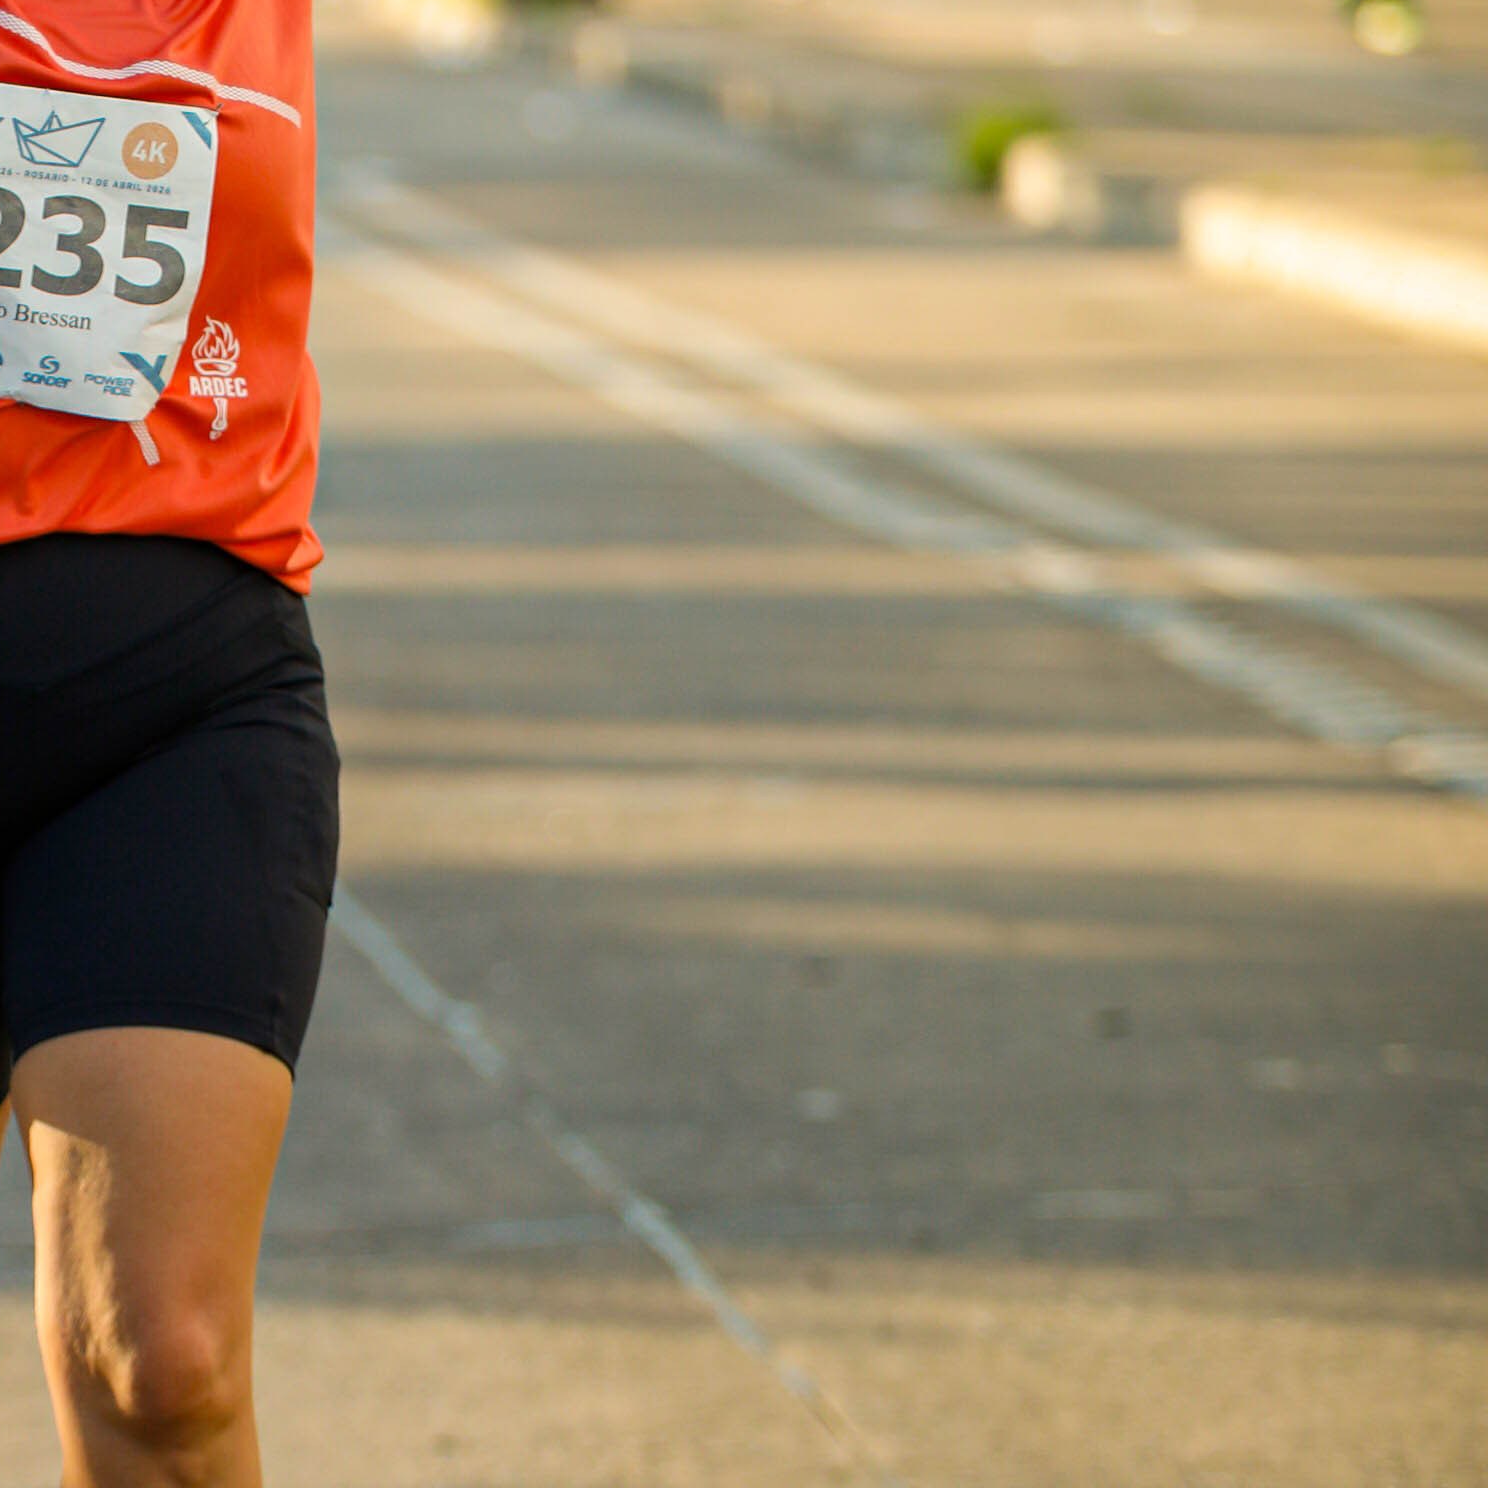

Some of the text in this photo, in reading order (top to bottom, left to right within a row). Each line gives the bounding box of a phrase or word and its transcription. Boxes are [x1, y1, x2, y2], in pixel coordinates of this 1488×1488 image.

[131, 137, 169, 164] 4K
[23, 169, 69, 183] ROSARIO
[81, 177, 94, 186] 12
[95, 178, 109, 188] DE
[112, 180, 142, 192] ABRIL
[146, 184, 172, 195] 2026
[13, 303, 92, 331] Bressan
[189, 375, 248, 398] ARDEC
